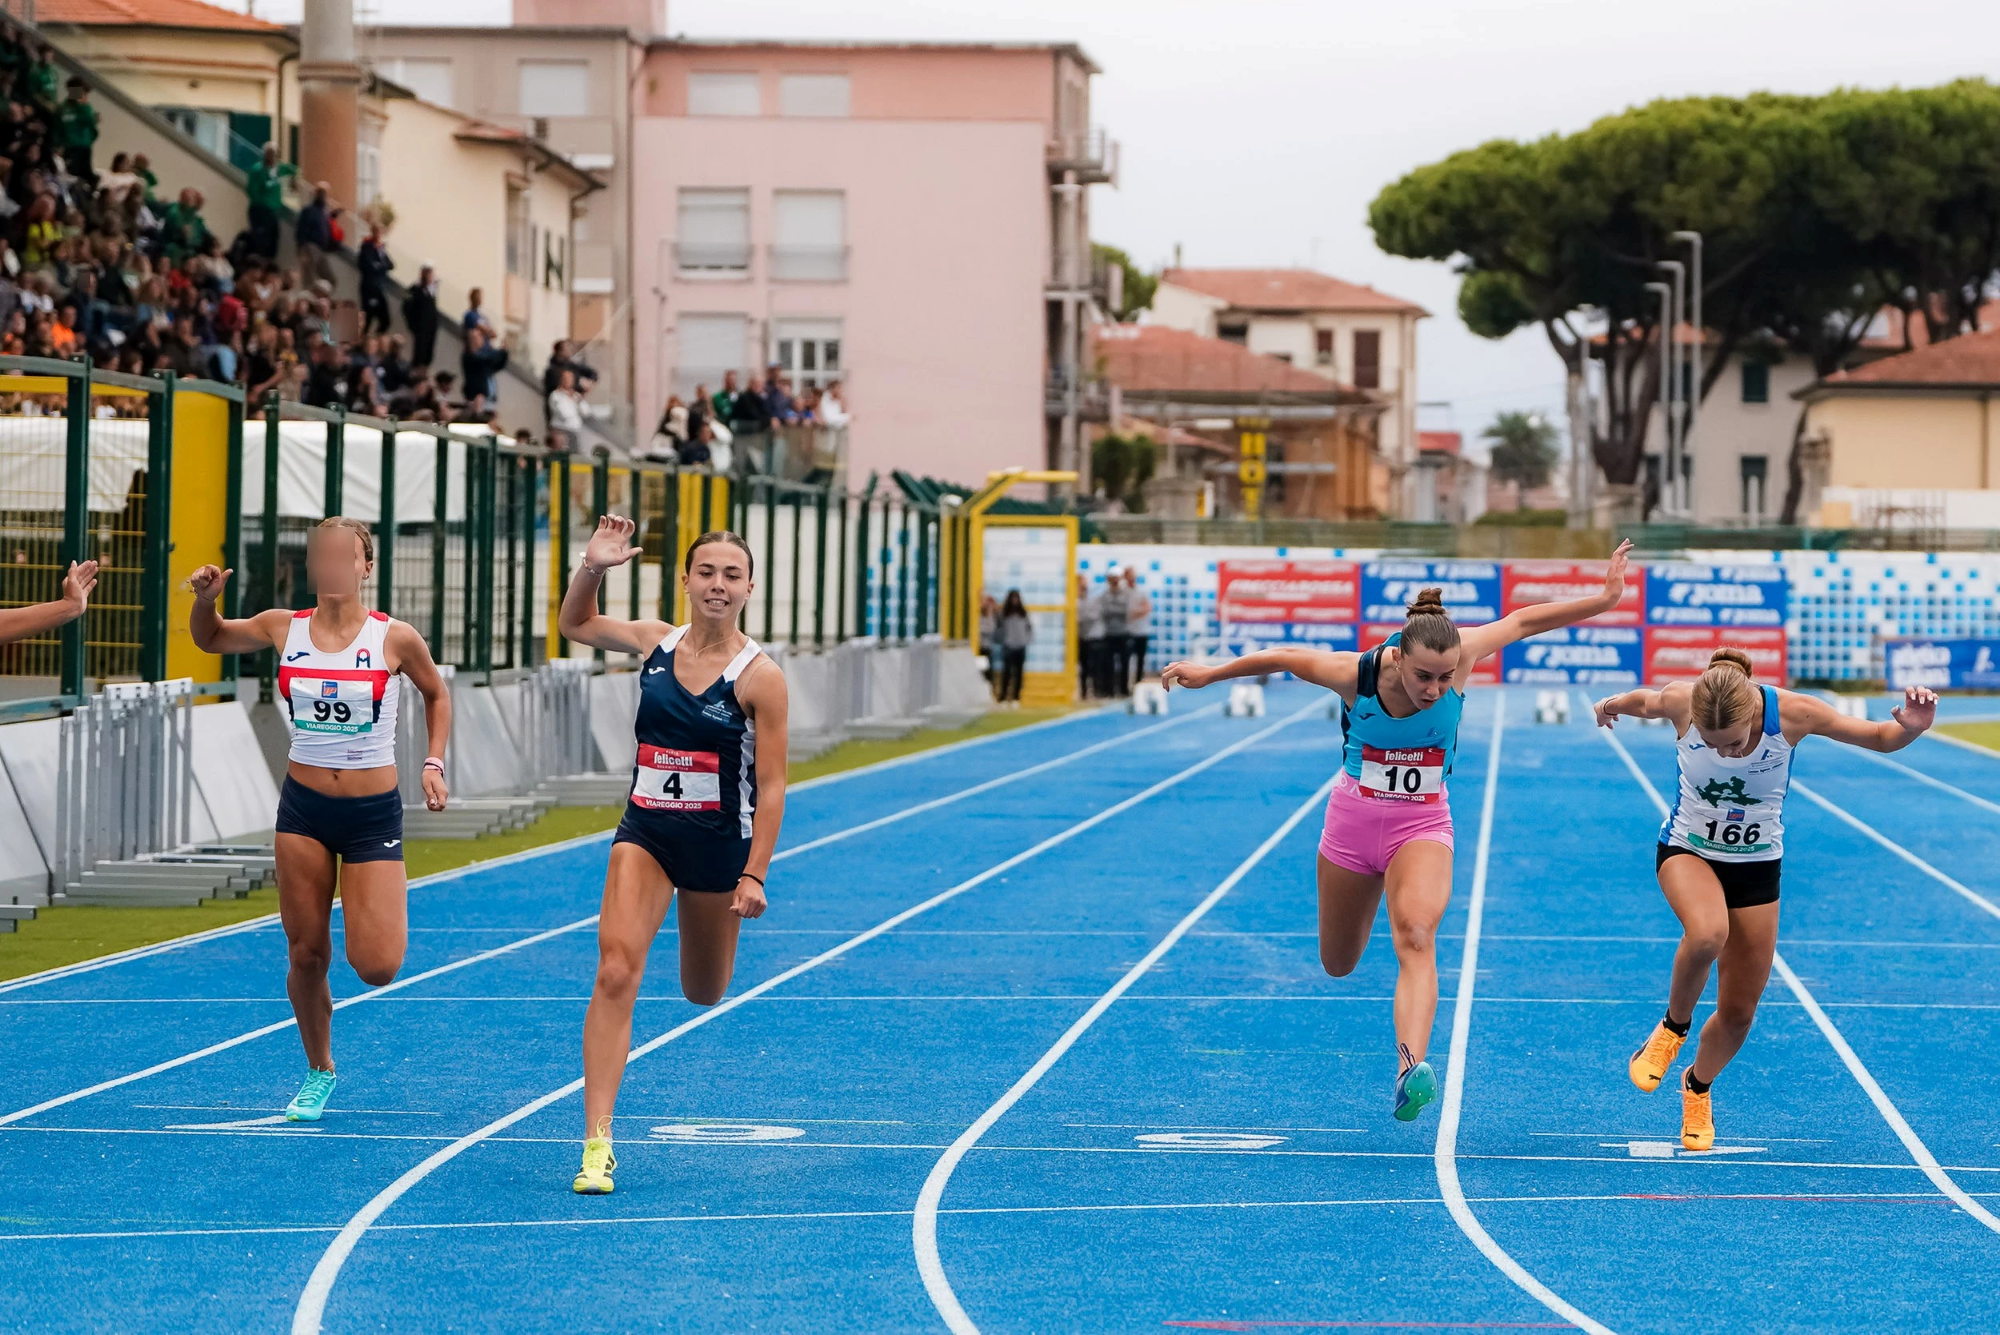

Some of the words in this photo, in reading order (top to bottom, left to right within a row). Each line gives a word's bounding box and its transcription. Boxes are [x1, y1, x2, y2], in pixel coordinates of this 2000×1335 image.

[313, 700, 352, 723] 99
[305, 722, 342, 731] VIAREGGIO
[342, 725, 359, 733] 2025
[653, 751, 693, 767] felicetti
[1384, 750, 1424, 762] felicetti
[662, 772, 684, 800] 4
[1384, 766, 1422, 794] 10
[645, 799, 684, 809] VIAREGGIO
[684, 800, 702, 809] 2025
[1705, 820, 1761, 845] 166
[1702, 840, 1739, 852] VIAREGGIO
